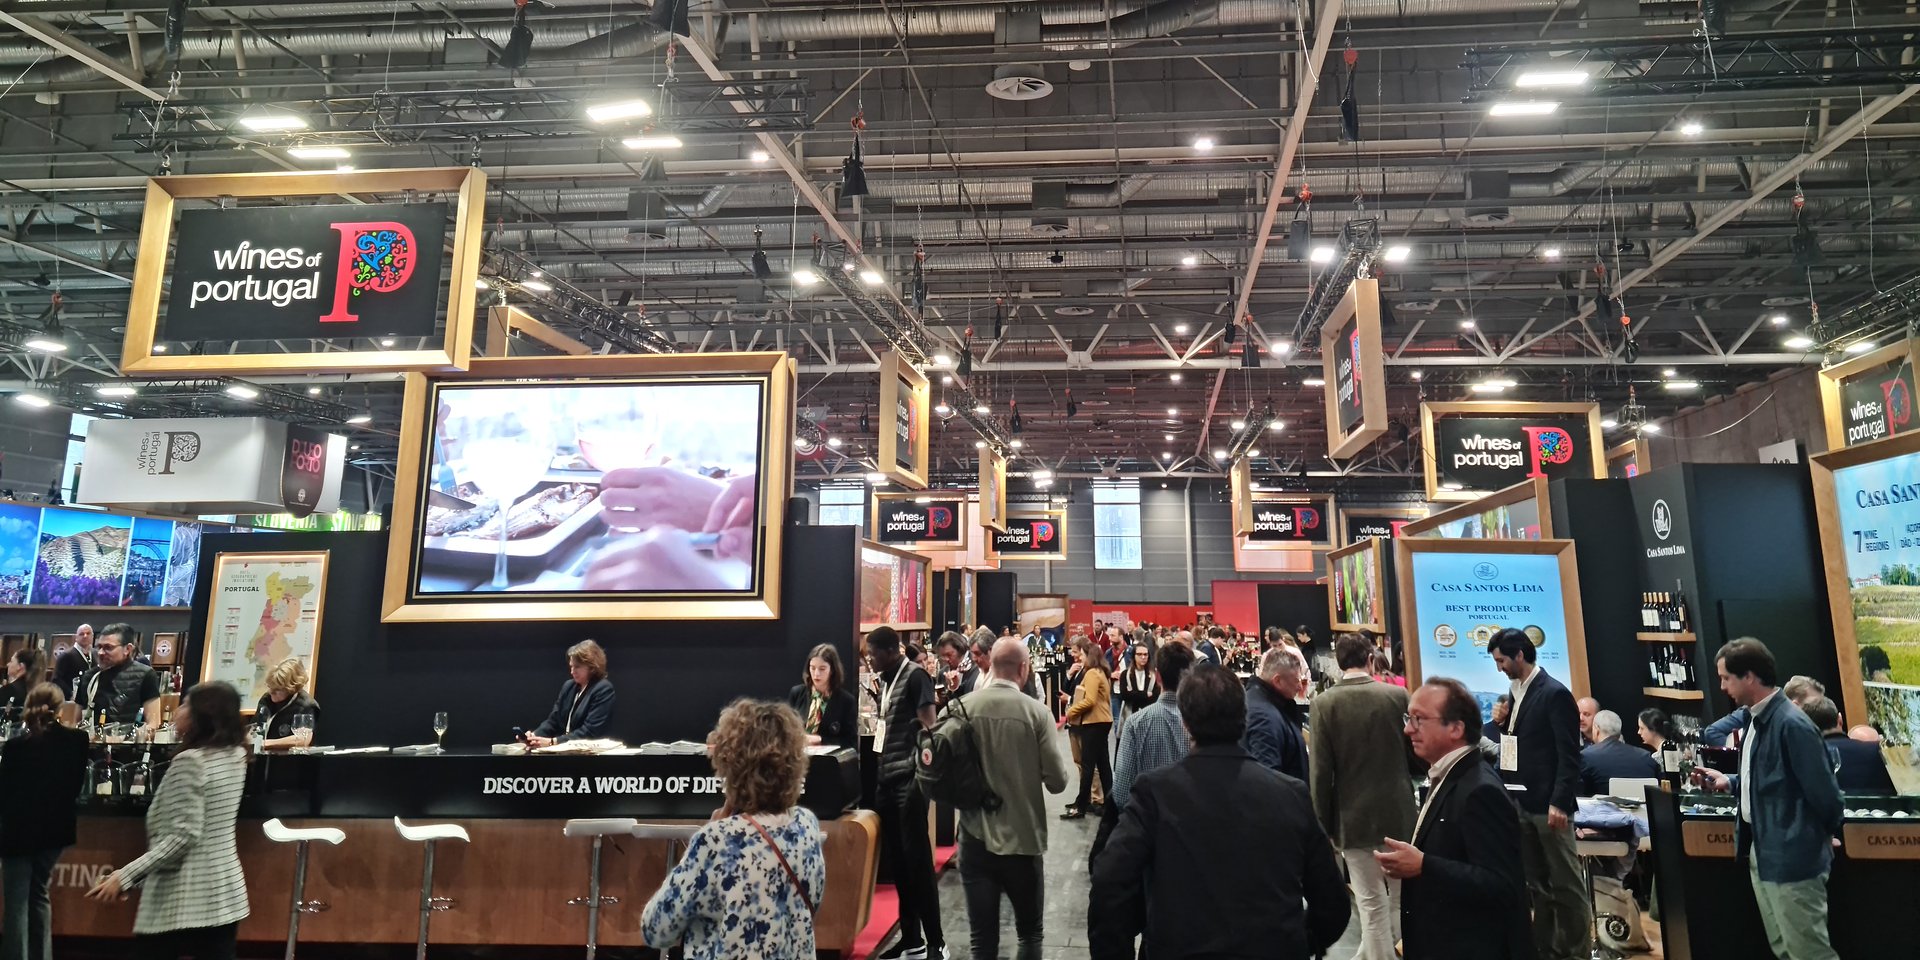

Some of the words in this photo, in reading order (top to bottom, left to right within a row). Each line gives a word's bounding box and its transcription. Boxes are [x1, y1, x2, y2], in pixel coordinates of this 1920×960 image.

[213, 240, 304, 271] wines
[305, 252, 323, 268] of
[190, 272, 321, 309] portugal
[1850, 400, 1877, 421] wines
[1848, 415, 1886, 446] portugal
[1461, 433, 1512, 451] wines
[1512, 441, 1522, 450] of
[136, 437, 150, 470] wines
[147, 431, 161, 475] portugal
[1454, 451, 1524, 470] portugal
[1856, 489, 1890, 509] CASA
[892, 511, 919, 522] wines
[1258, 511, 1285, 522] wines
[887, 520, 925, 533] portugal
[1254, 521, 1292, 532] portugal
[1360, 525, 1384, 534] wines
[997, 534, 1030, 545] portugal
[1852, 530, 1862, 553] 7
[1863, 530, 1878, 540] WINE
[1865, 541, 1890, 552] REGIONS
[1431, 583, 1462, 592] CASA
[1464, 583, 1510, 593] SANTOS
[1513, 583, 1544, 592] LIMA
[1474, 605, 1531, 613] PRODUCER
[483, 777, 574, 794] DISCOVER
[577, 777, 591, 794] A
[594, 776, 663, 794] WORLD
[665, 776, 690, 794] OF
[1867, 835, 1897, 846] CASA
